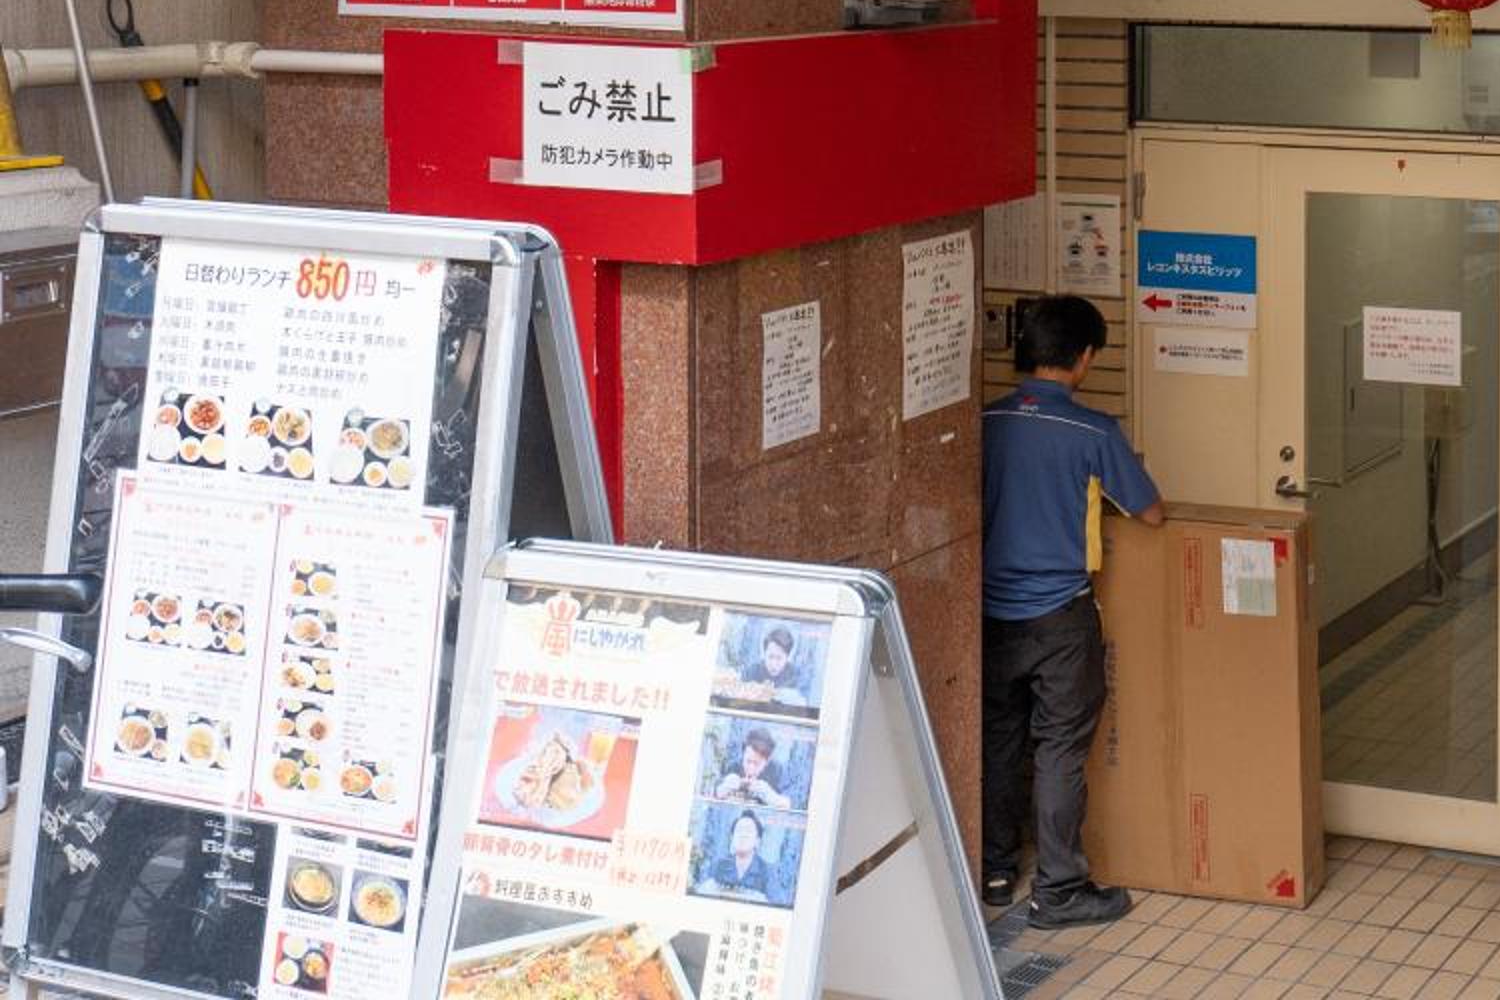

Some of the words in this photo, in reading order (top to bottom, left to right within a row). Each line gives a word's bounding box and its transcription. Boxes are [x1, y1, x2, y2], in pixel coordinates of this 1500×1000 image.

[540, 76, 676, 122] ごみ禁止
[541, 144, 674, 171] 防犯カメラ作動中
[184, 263, 292, 289] 日替わりランチ
[296, 258, 351, 301] 850
[354, 269, 378, 297] 円
[495, 878, 593, 907] 料理長おすすめ
